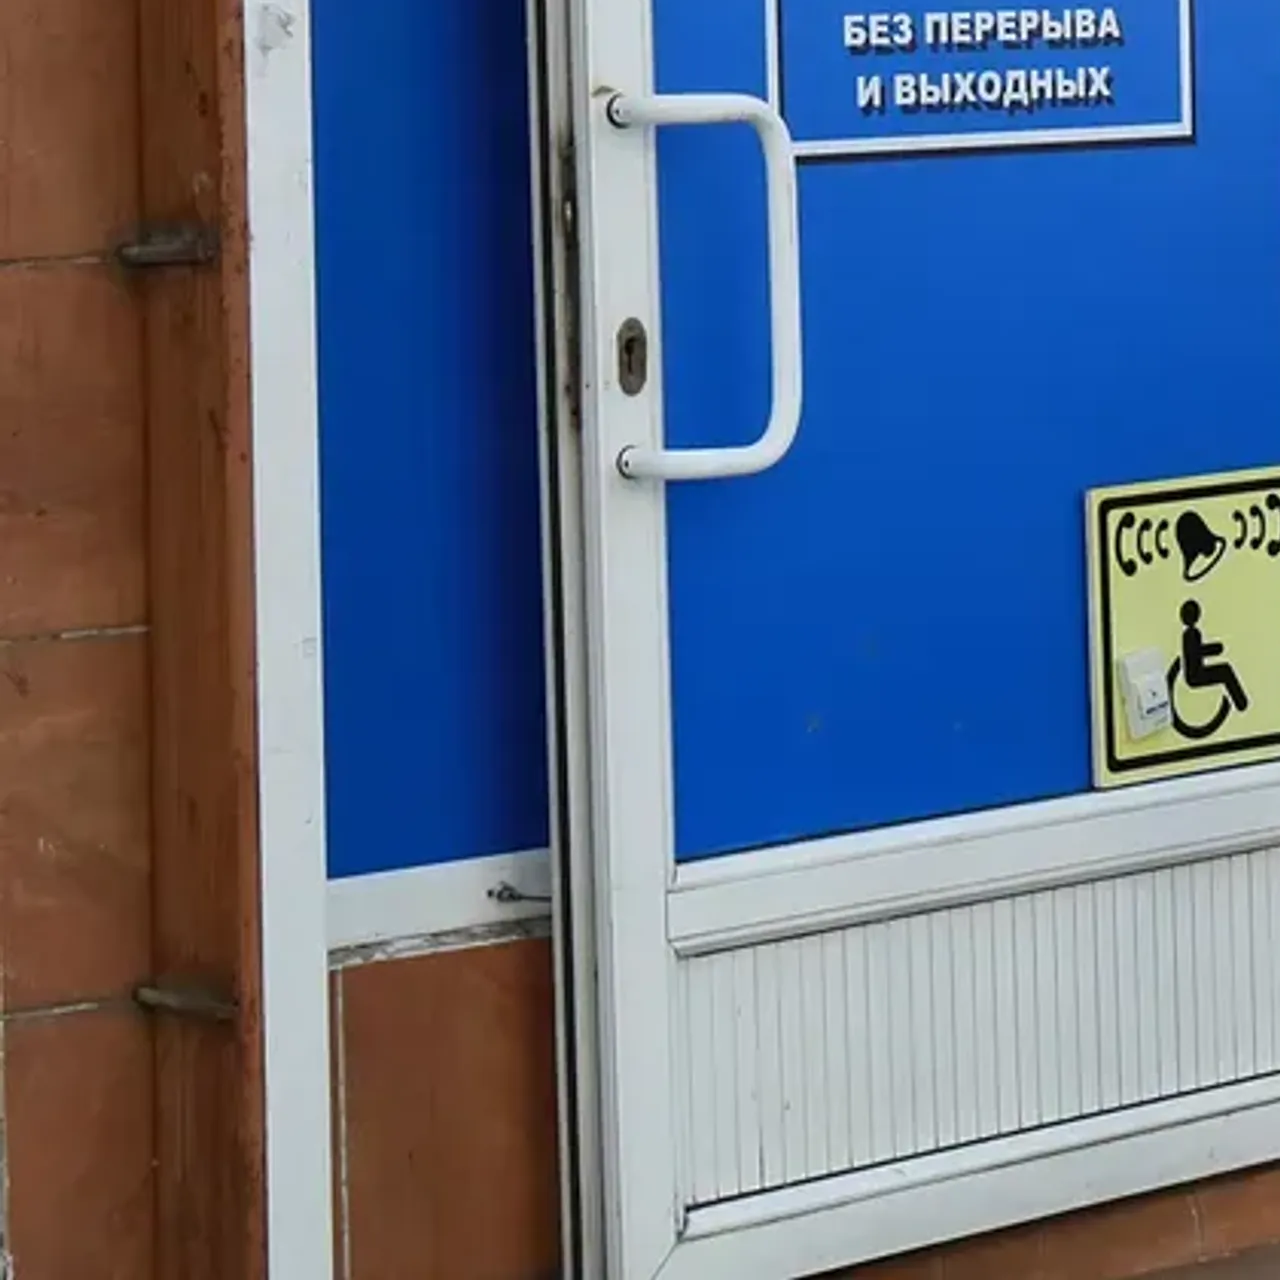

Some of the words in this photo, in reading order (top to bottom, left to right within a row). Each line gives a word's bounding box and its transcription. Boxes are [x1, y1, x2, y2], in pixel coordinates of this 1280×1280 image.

[842, 14, 912, 48] БЕЗ
[924, 8, 1121, 46] ПЕРЕРЫВА
[856, 76, 881, 108] И
[893, 67, 1112, 108] ВЫХОДНЫХ
